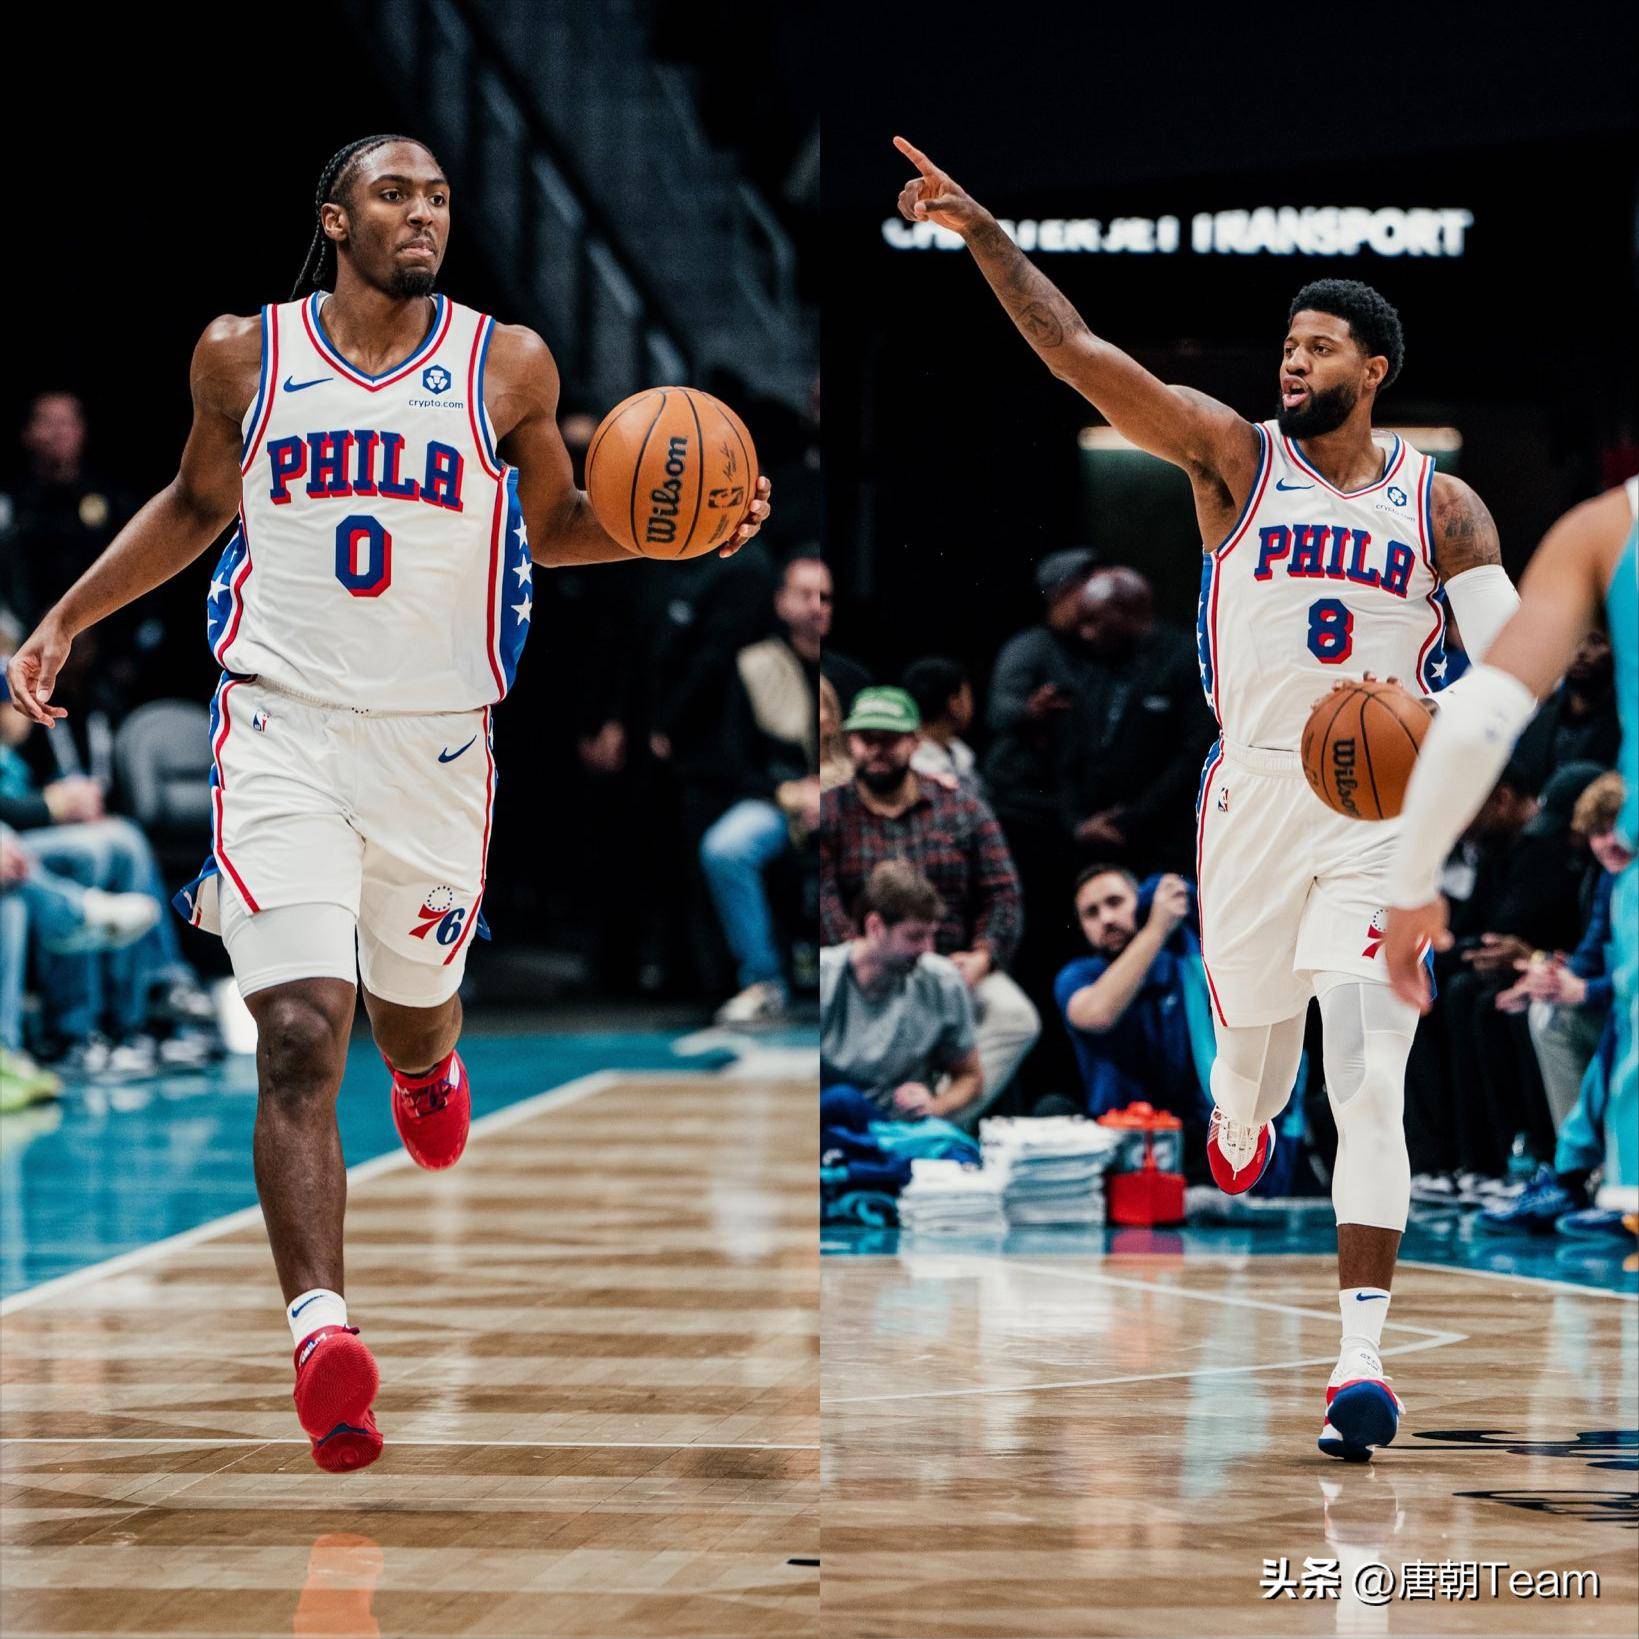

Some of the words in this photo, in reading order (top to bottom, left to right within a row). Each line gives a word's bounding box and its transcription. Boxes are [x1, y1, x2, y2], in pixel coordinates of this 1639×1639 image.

[1192, 206, 1474, 256] TRANSPORT
[408, 399, 464, 408] crypto.com
[267, 429, 464, 513] PHILA
[646, 436, 688, 543] Wilson
[335, 514, 392, 597] 0
[1254, 524, 1416, 599] PHILA
[1307, 598, 1354, 664] 8
[408, 903, 466, 946] 76
